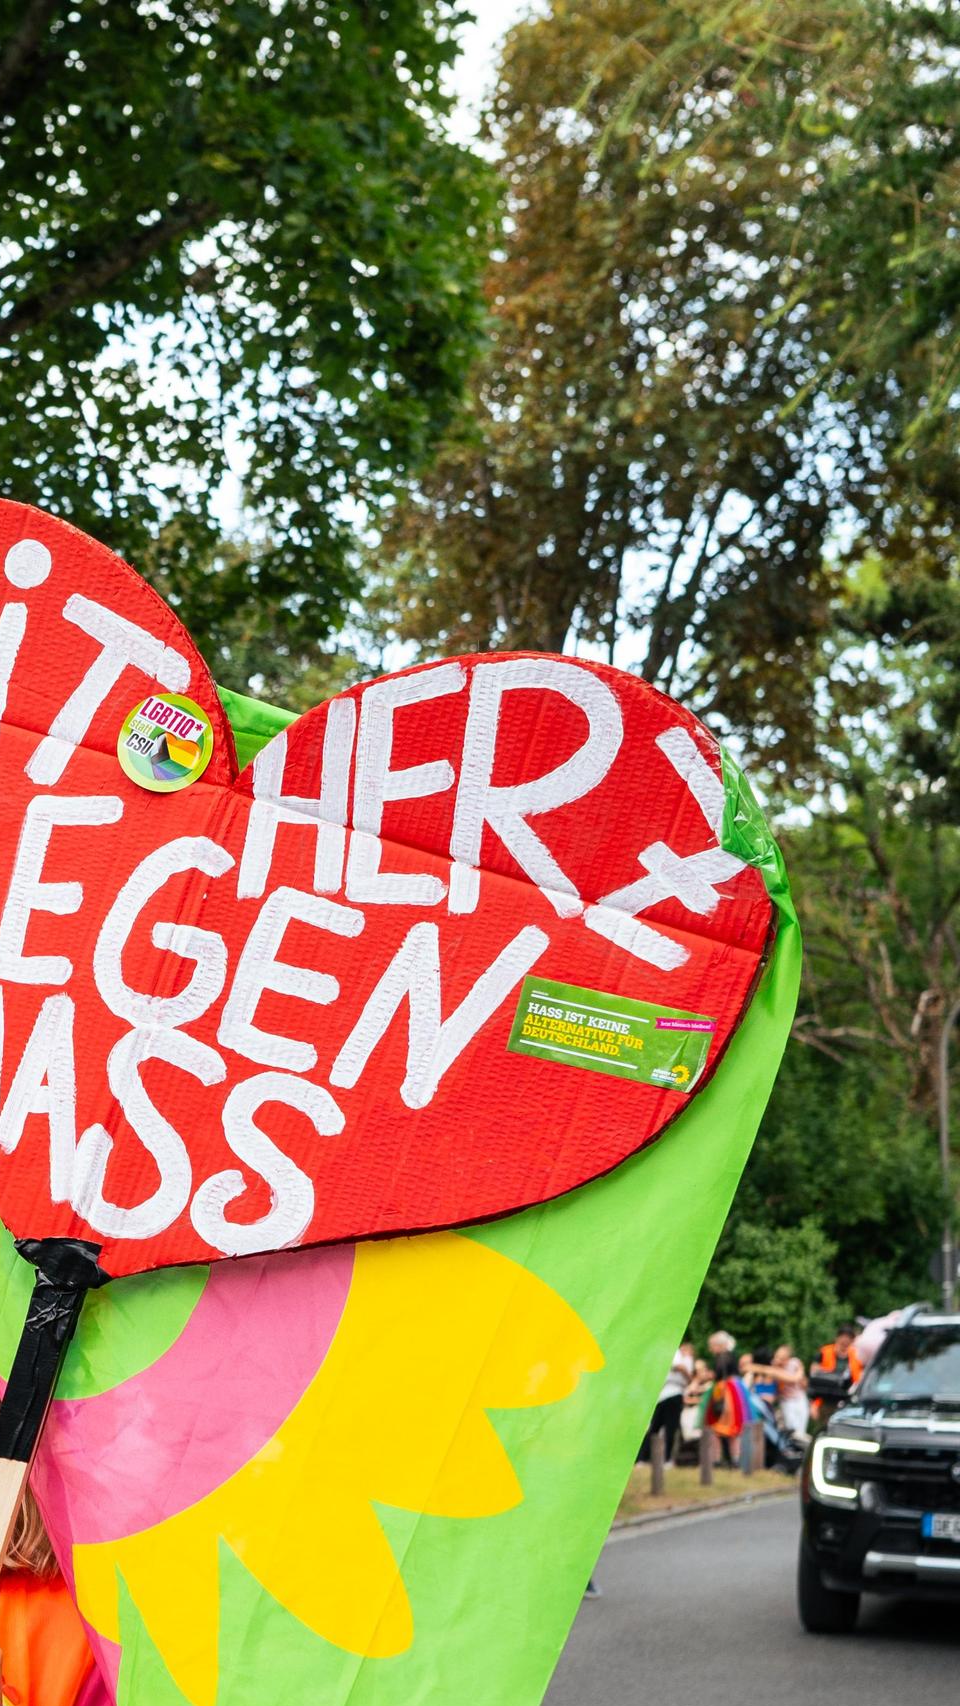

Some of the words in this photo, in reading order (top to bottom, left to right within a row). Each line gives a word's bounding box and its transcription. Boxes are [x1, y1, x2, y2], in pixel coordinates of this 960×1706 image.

[130, 719, 153, 735] statt
[126, 733, 154, 755] CSU
[524, 1013, 615, 1044] ALTERNATIVE
[616, 1035, 644, 1050] FÜR
[527, 1002, 563, 1020] HASS
[565, 1010, 587, 1026] IST
[587, 1015, 631, 1035] KEINE
[522, 1024, 621, 1057] DEUTSCHLAND.
